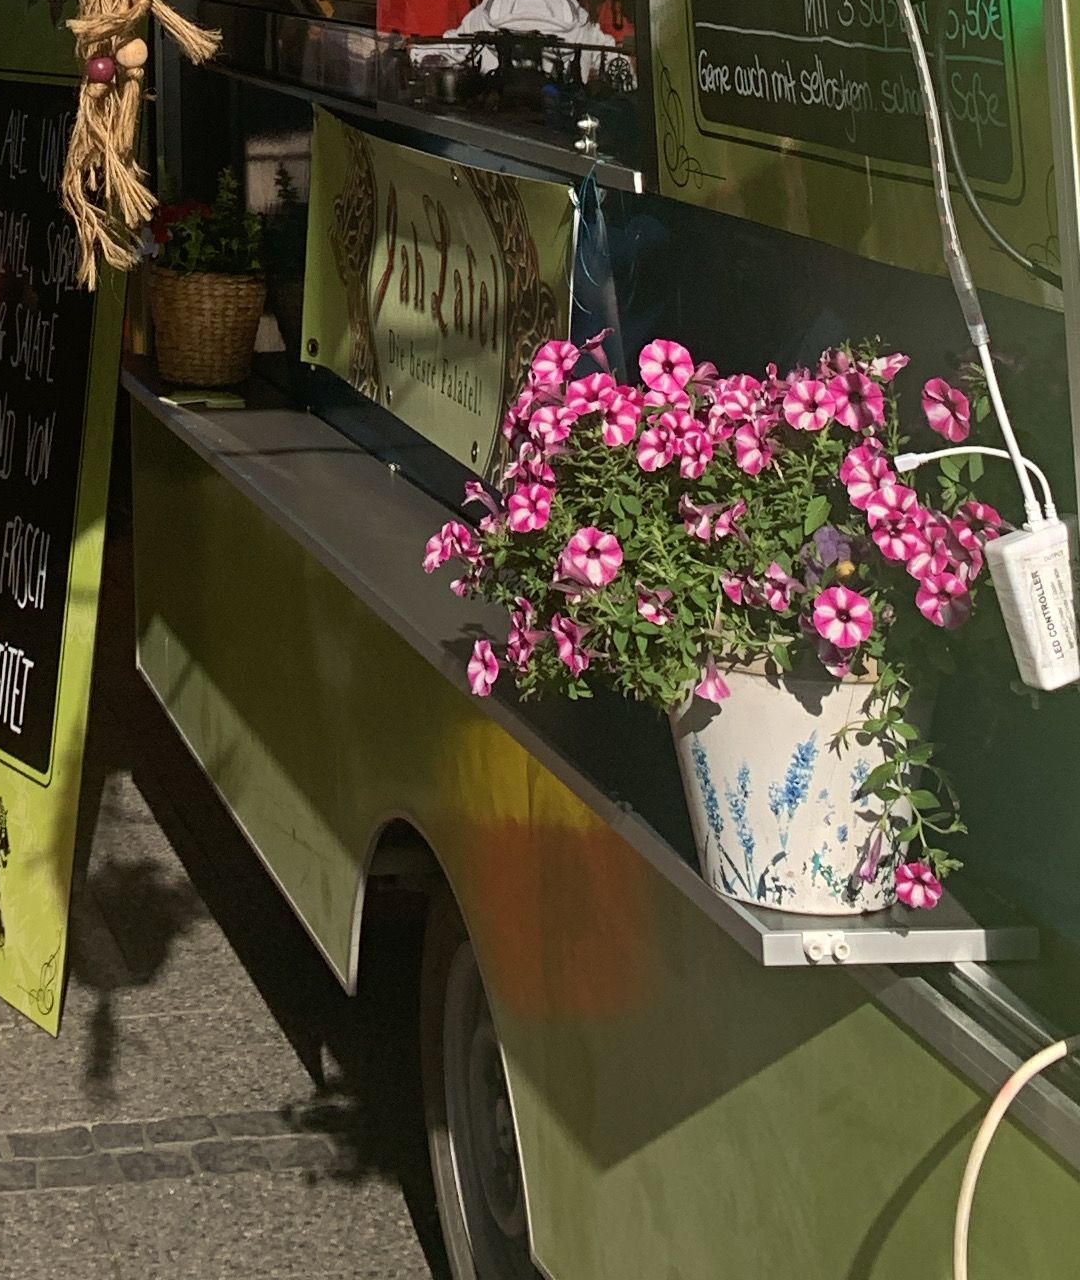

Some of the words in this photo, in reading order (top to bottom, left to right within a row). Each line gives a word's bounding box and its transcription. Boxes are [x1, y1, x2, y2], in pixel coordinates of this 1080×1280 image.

[733, 53, 771, 104] auch
[771, 58, 797, 105] mit
[373, 180, 426, 327] Jah
[10, 302, 60, 383] SALATE
[388, 328, 405, 372] Die
[409, 339, 437, 390] beste
[441, 359, 482, 417] Falafel!
[24, 410, 56, 486] VON
[1030, 569, 1058, 638] CONTROLLER
[1051, 639, 1065, 661] LED
